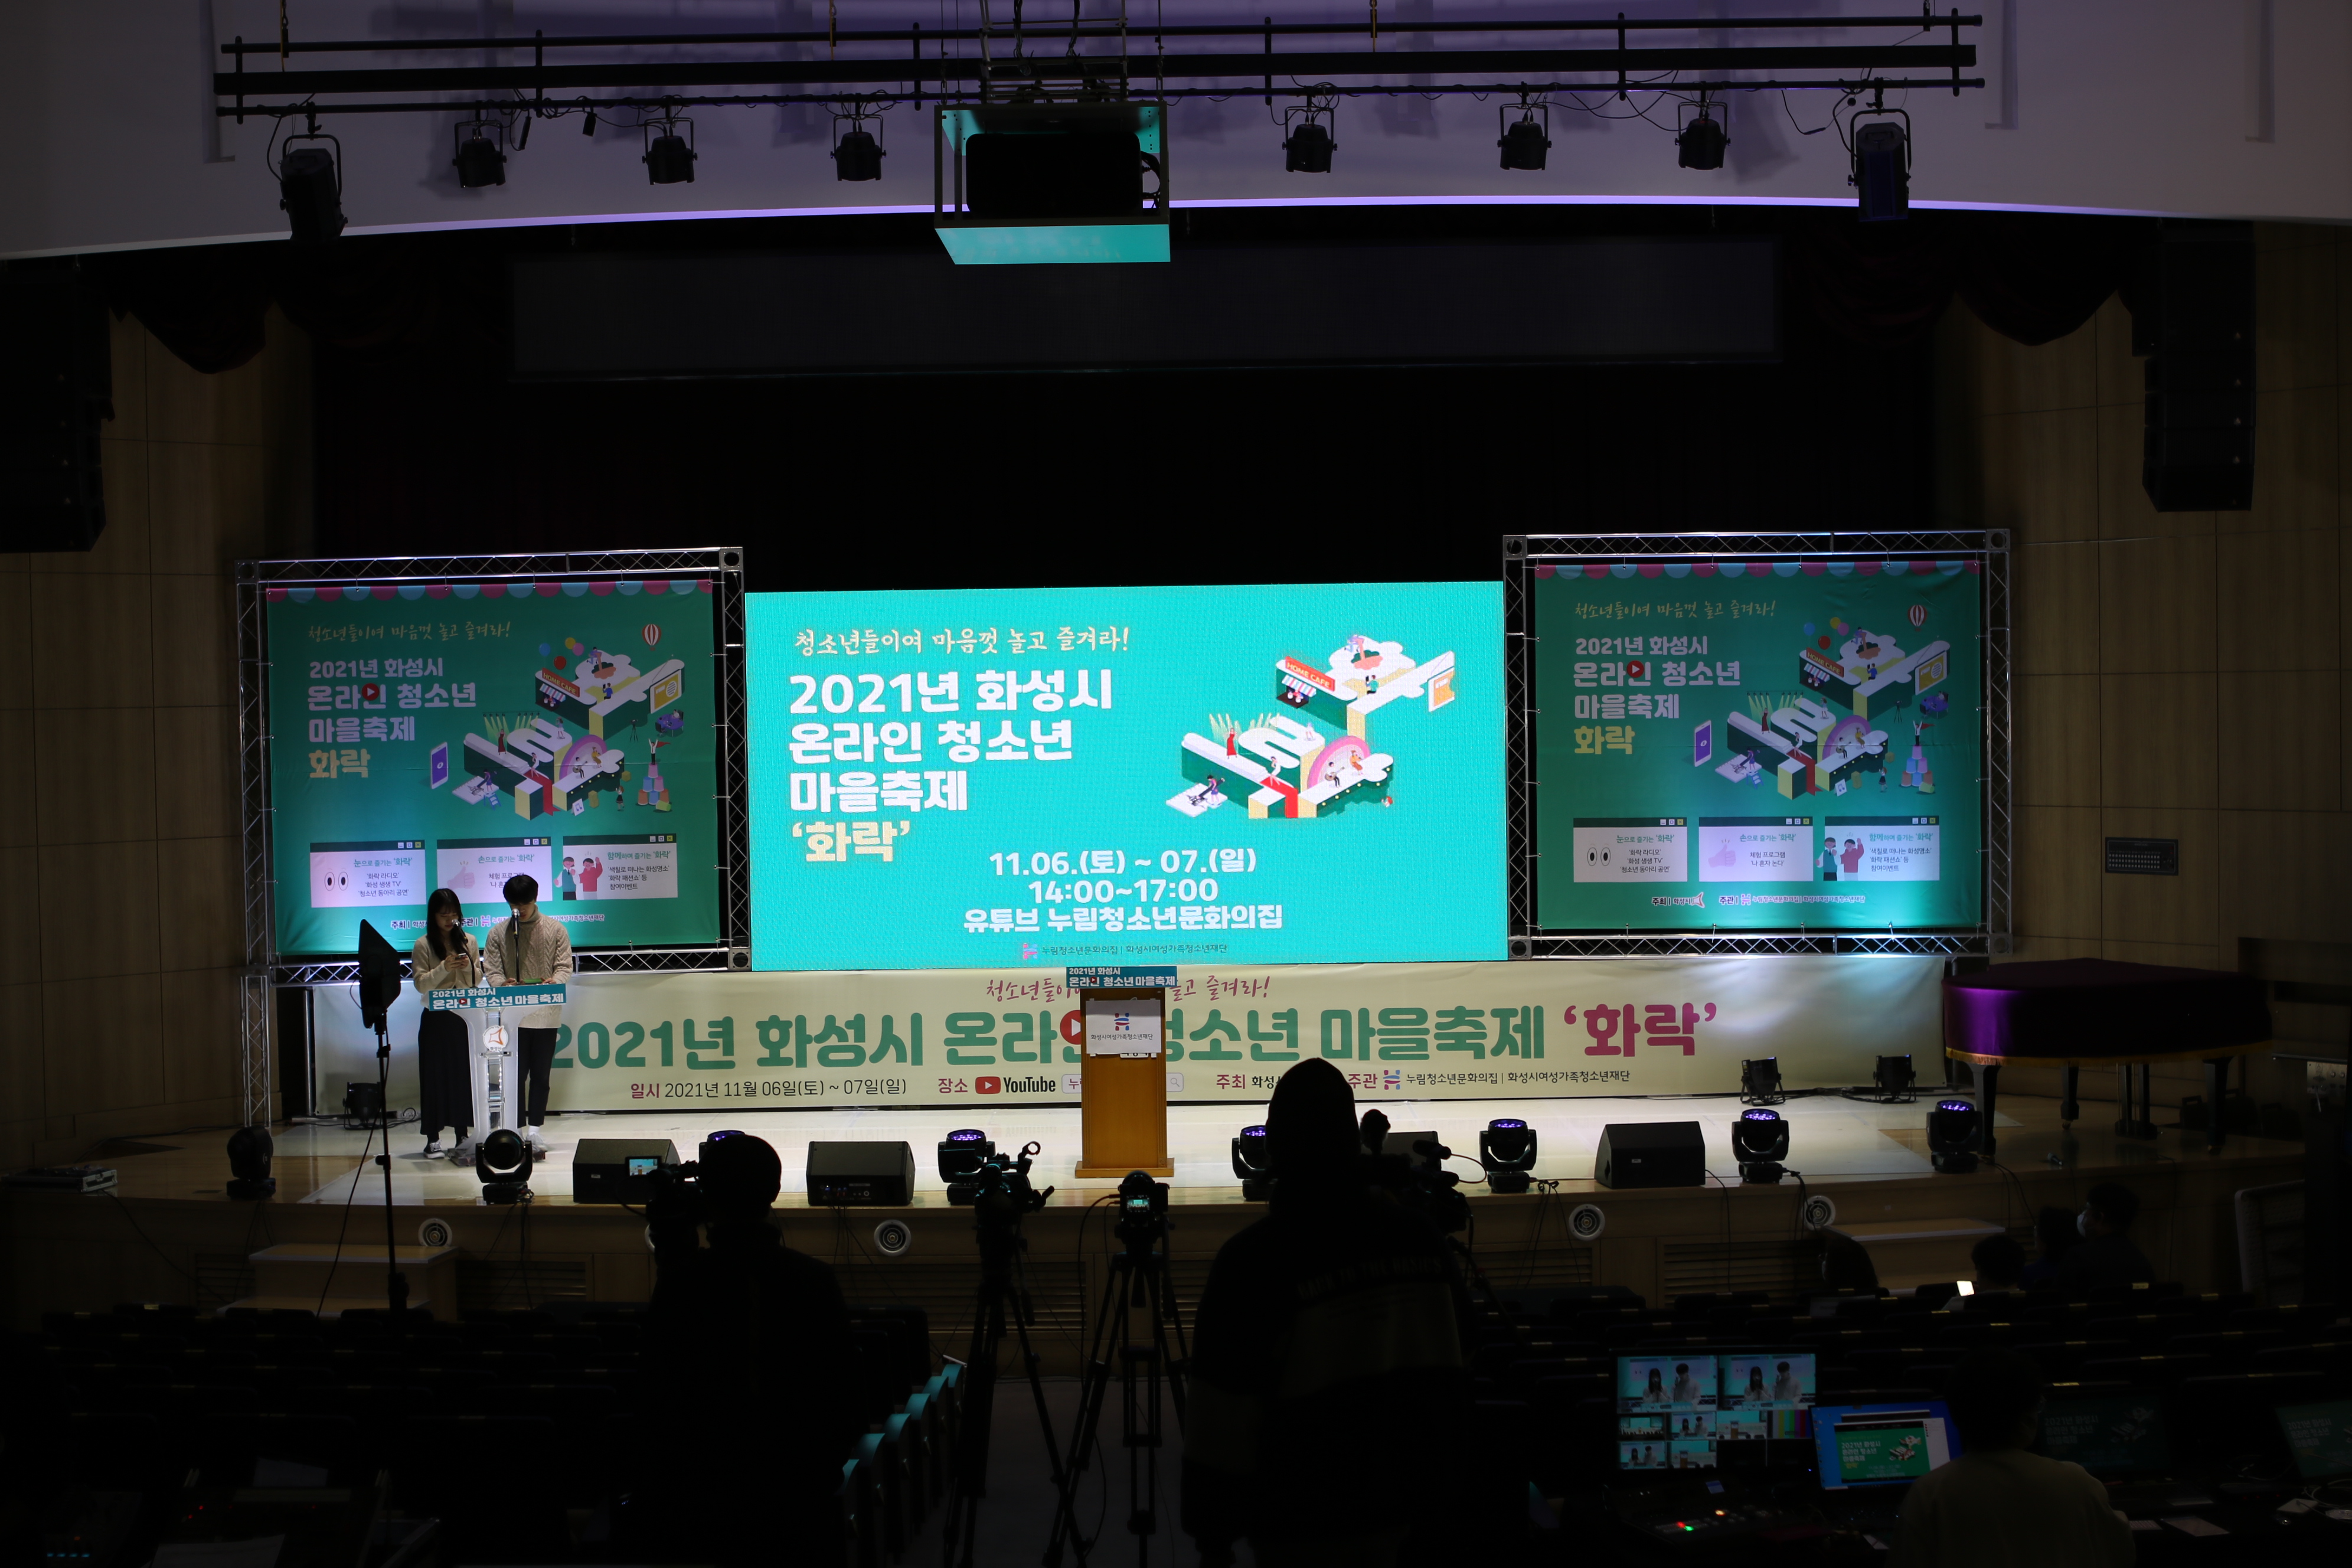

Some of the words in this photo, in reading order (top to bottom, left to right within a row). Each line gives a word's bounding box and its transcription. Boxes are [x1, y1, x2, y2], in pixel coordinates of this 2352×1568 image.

[1575, 601, 1651, 620] 청소년들이여
[1657, 601, 1698, 619] 마음껏
[1703, 600, 1724, 619] 놀고
[1730, 600, 1776, 619] 즐겨라!
[308, 624, 384, 643] 청소년들이여
[391, 623, 433, 641] 마음껏
[439, 623, 459, 642] 놀고
[465, 620, 511, 641] 즐겨라!
[794, 628, 922, 656] 청소년들이여
[932, 627, 998, 655] 마음껏
[1007, 628, 1048, 654] 놀고
[1056, 626, 1128, 653] 즐겨라!
[1575, 636, 1644, 655] 2021년
[1649, 635, 1708, 655] 화성시
[309, 658, 378, 679] 2021년
[384, 657, 443, 678] 화성시
[1573, 659, 1651, 687] 온라인
[1662, 661, 1741, 687] 청소년
[1807, 652, 1825, 666] HOME
[1825, 661, 1841, 675] CAFE
[543, 672, 561, 687] HOME
[561, 682, 576, 695] CAFE
[1287, 662, 1309, 680] HOME
[1310, 674, 1331, 689] CAFE
[307, 682, 387, 711] 온라인
[397, 682, 476, 709] 청소년
[789, 671, 959, 714] 2021년
[975, 669, 1112, 712] 화성시
[1574, 693, 1680, 720] 마을축제
[309, 716, 416, 743] 마을축제
[1574, 725, 1635, 755] 화락
[789, 720, 922, 765] 온라인
[937, 720, 1072, 763] 청소년
[308, 749, 371, 779] 화락
[789, 770, 968, 814] 마을축제
[792, 819, 910, 863] ‘화락’
[1616, 835, 1635, 844] 눈으로
[1739, 834, 1758, 842] 손으로
[1869, 833, 1895, 842] 함께하며
[354, 859, 373, 868] 눈으로
[478, 855, 496, 864] 손으로
[607, 852, 633, 861] 함께하며
[989, 850, 1126, 876] 11.06.(토)
[1160, 847, 1257, 873] 07.(일)
[1028, 878, 1219, 904] 14:00~17:00
[1652, 897, 1667, 906] 주최
[1673, 897, 1692, 906] 화성시
[1719, 896, 1734, 905] 주관
[391, 920, 406, 929] 주최
[963, 908, 1040, 933] 유튜브
[1047, 904, 1282, 932] 누림청소년문화의집
[1042, 945, 1118, 955] 누림청소년문화의집
[1125, 943, 1228, 955] 화성시여성가족청소년재단
[1069, 967, 1096, 975] 2021년
[1097, 967, 1121, 975] 화성시
[1069, 976, 1100, 987] 온라인
[1103, 976, 1134, 987] 청소년
[1135, 976, 1175, 986] 마을축제
[432, 989, 465, 998] 2021년
[468, 988, 496, 996] 화성시
[1206, 975, 1270, 1001] 즐겨라!
[433, 998, 471, 1009] 온라인
[475, 996, 512, 1007] 청소년
[515, 993, 564, 1004] 마을축제
[550, 1016, 736, 1070] 2021년
[755, 1012, 923, 1069] 화성시
[1320, 1005, 1544, 1061] 마을축제
[1564, 1002, 1717, 1057] ‘화락’
[631, 1083, 661, 1099] 일시
[664, 1082, 720, 1098] 2021년
[724, 1081, 758, 1097] 11월
[762, 1079, 825, 1097] 06일(토)
[843, 1077, 907, 1096] 07일(일)
[937, 1078, 969, 1095] 장소
[1004, 1076, 1056, 1094] YouTube
[1216, 1074, 1246, 1090] 주최
[1348, 1073, 1378, 1089] 주관
[1406, 1072, 1500, 1086] 누림청소년문화의집
[1507, 1069, 1631, 1084] 화성시여성가족청소년재단
[1841, 1440, 1862, 1449] 2021년
